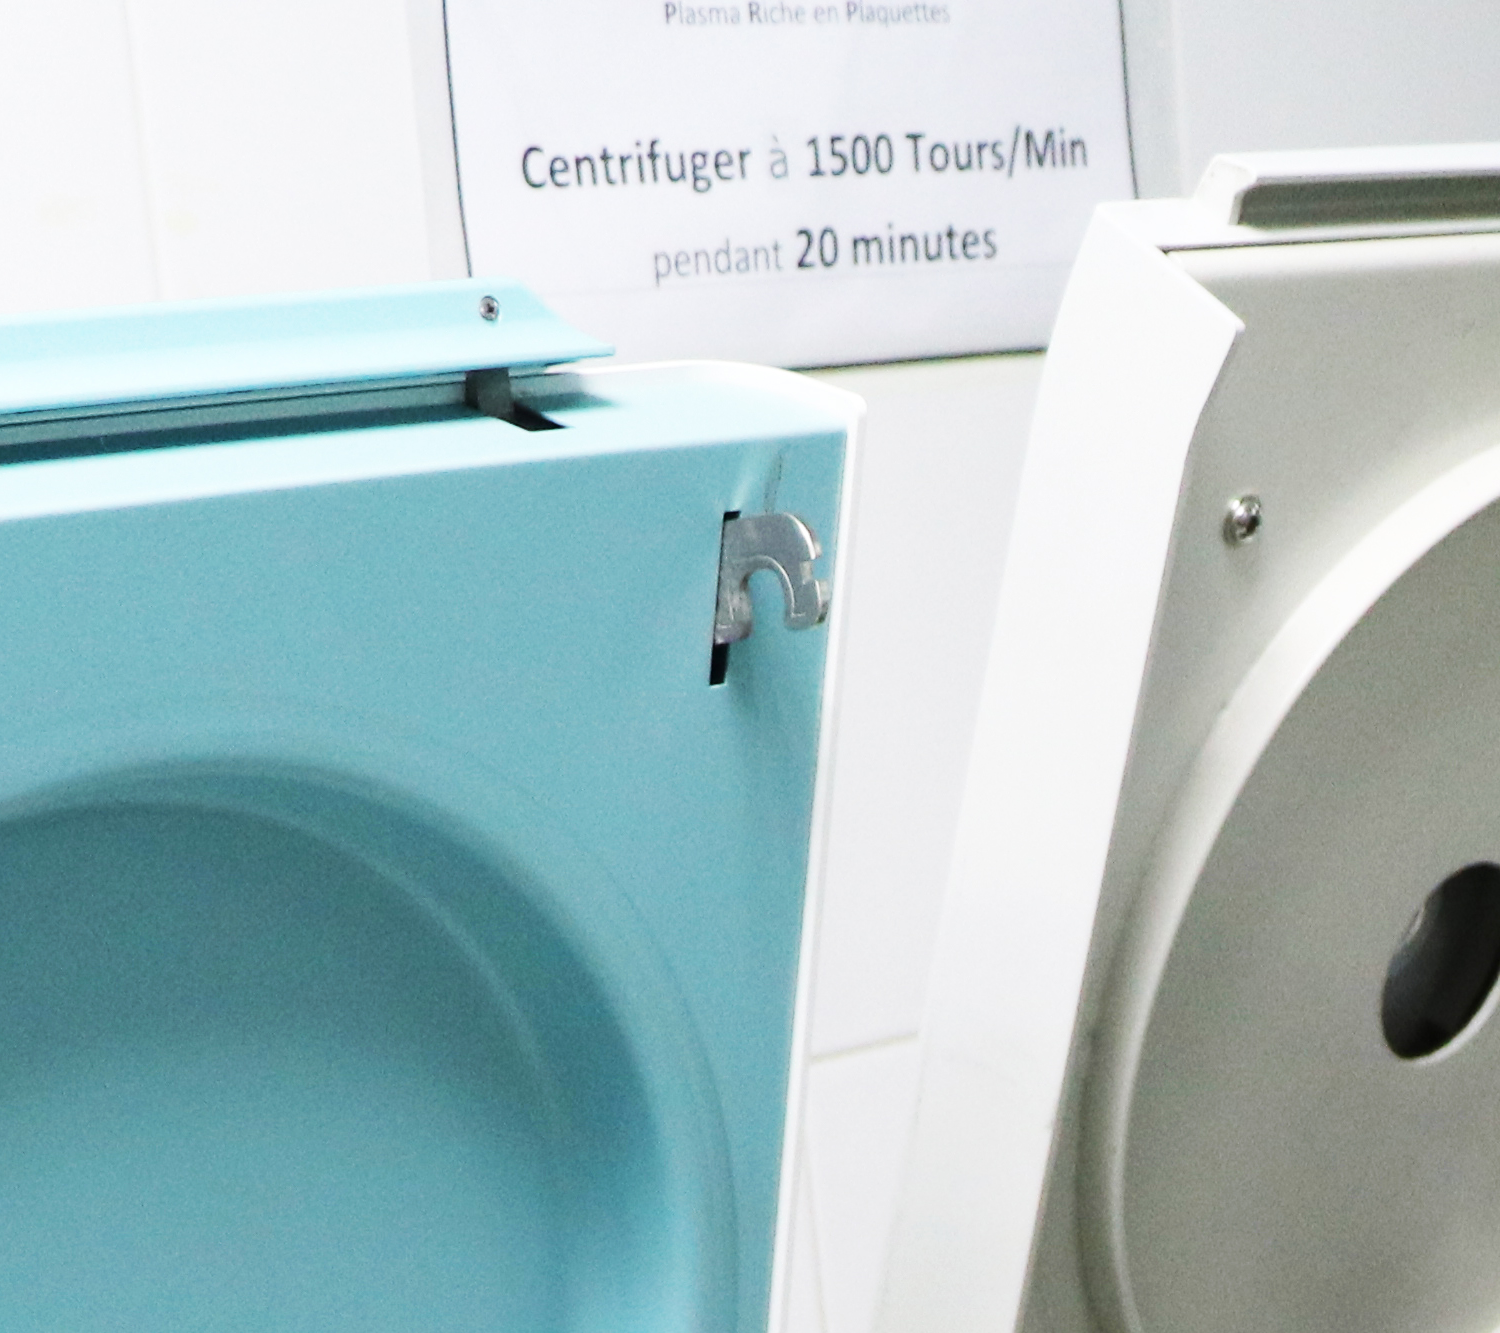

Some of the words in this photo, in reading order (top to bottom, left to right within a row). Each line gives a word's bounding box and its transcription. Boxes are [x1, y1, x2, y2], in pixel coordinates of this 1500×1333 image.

[664, 1, 741, 25] Plasma
[749, 1, 805, 25] Riche
[812, 6, 839, 24] en
[846, 1, 950, 27] Plaquettes
[521, 141, 752, 194] Centrifuger
[769, 133, 790, 180] à
[806, 133, 895, 178] 1500
[904, 124, 1089, 179] Tours/Min
[653, 238, 783, 286] pendant
[796, 227, 840, 271] 20
[851, 221, 999, 267] minutes
